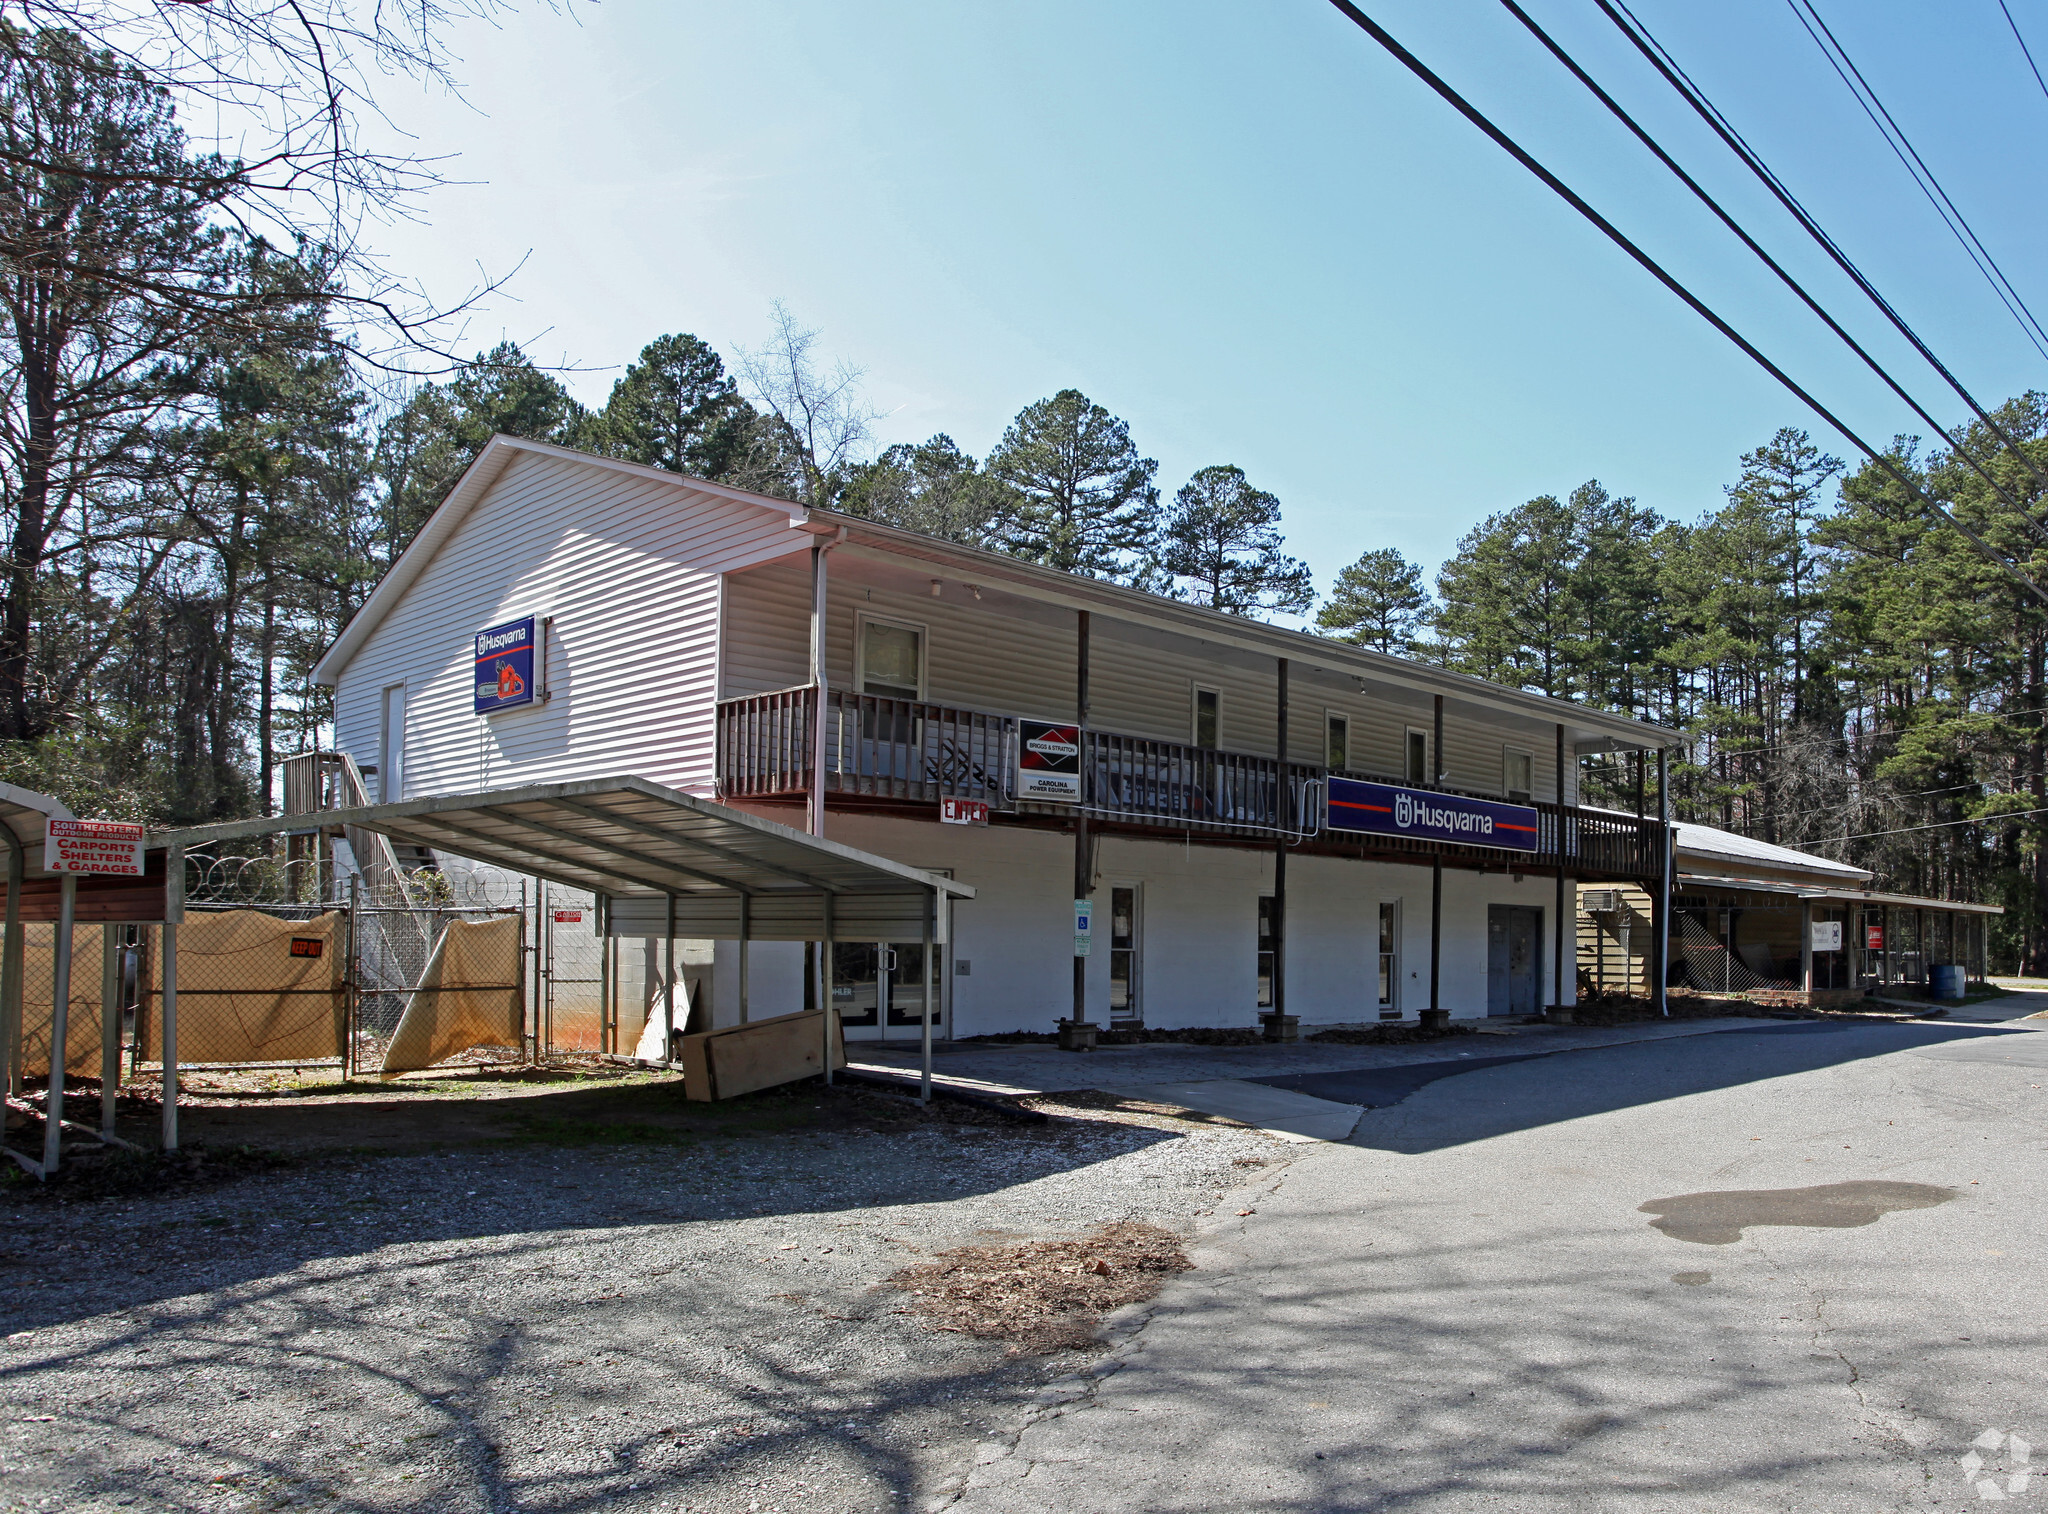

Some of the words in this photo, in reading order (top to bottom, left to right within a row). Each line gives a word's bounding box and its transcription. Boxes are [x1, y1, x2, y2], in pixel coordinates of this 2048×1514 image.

[486, 628, 525, 649] Husqvarna
[1029, 742, 1047, 750] BRIGGS
[1052, 745, 1075, 753] STRATTON
[1038, 780, 1068, 788] CAROLINA
[945, 799, 989, 821] ENTER
[1413, 800, 1492, 834] Husqvarna
[53, 821, 140, 834] SOUTHEASTERN
[52, 829, 94, 837] OUTDOOR
[97, 832, 139, 841] PRODUCTS
[57, 839, 136, 852] CARPORTS
[60, 850, 132, 862] SHELTERS
[51, 861, 62, 870] &
[68, 861, 138, 874] GARAGES
[291, 940, 308, 954] KEEP
[308, 941, 321, 956] OUT
